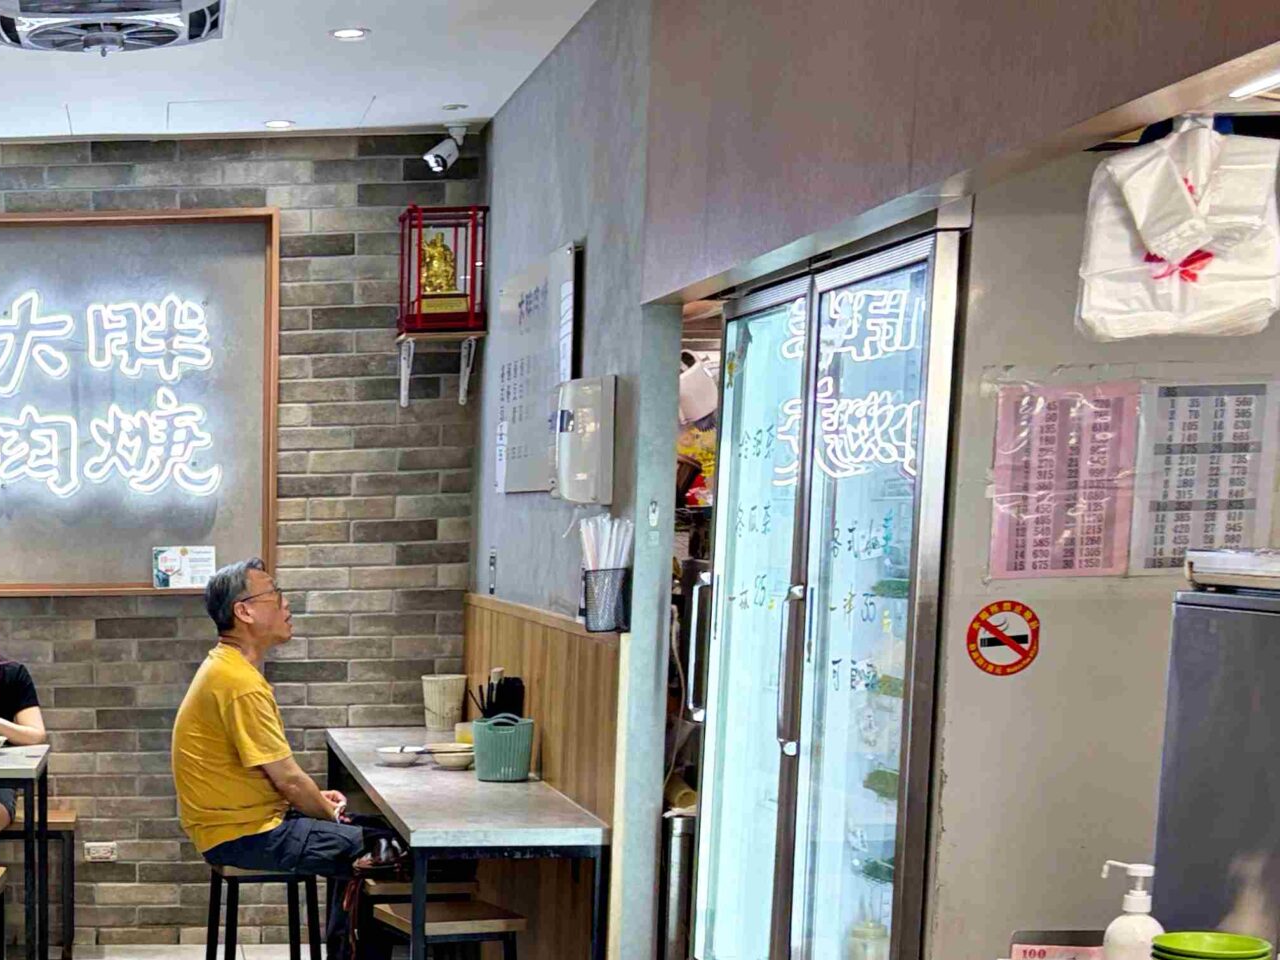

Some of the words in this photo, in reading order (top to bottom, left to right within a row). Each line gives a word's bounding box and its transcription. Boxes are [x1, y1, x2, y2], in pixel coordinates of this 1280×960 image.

[1036, 469, 1054, 479] 315
[1031, 560, 1048, 570] 675
[1022, 949, 1047, 959] 100
